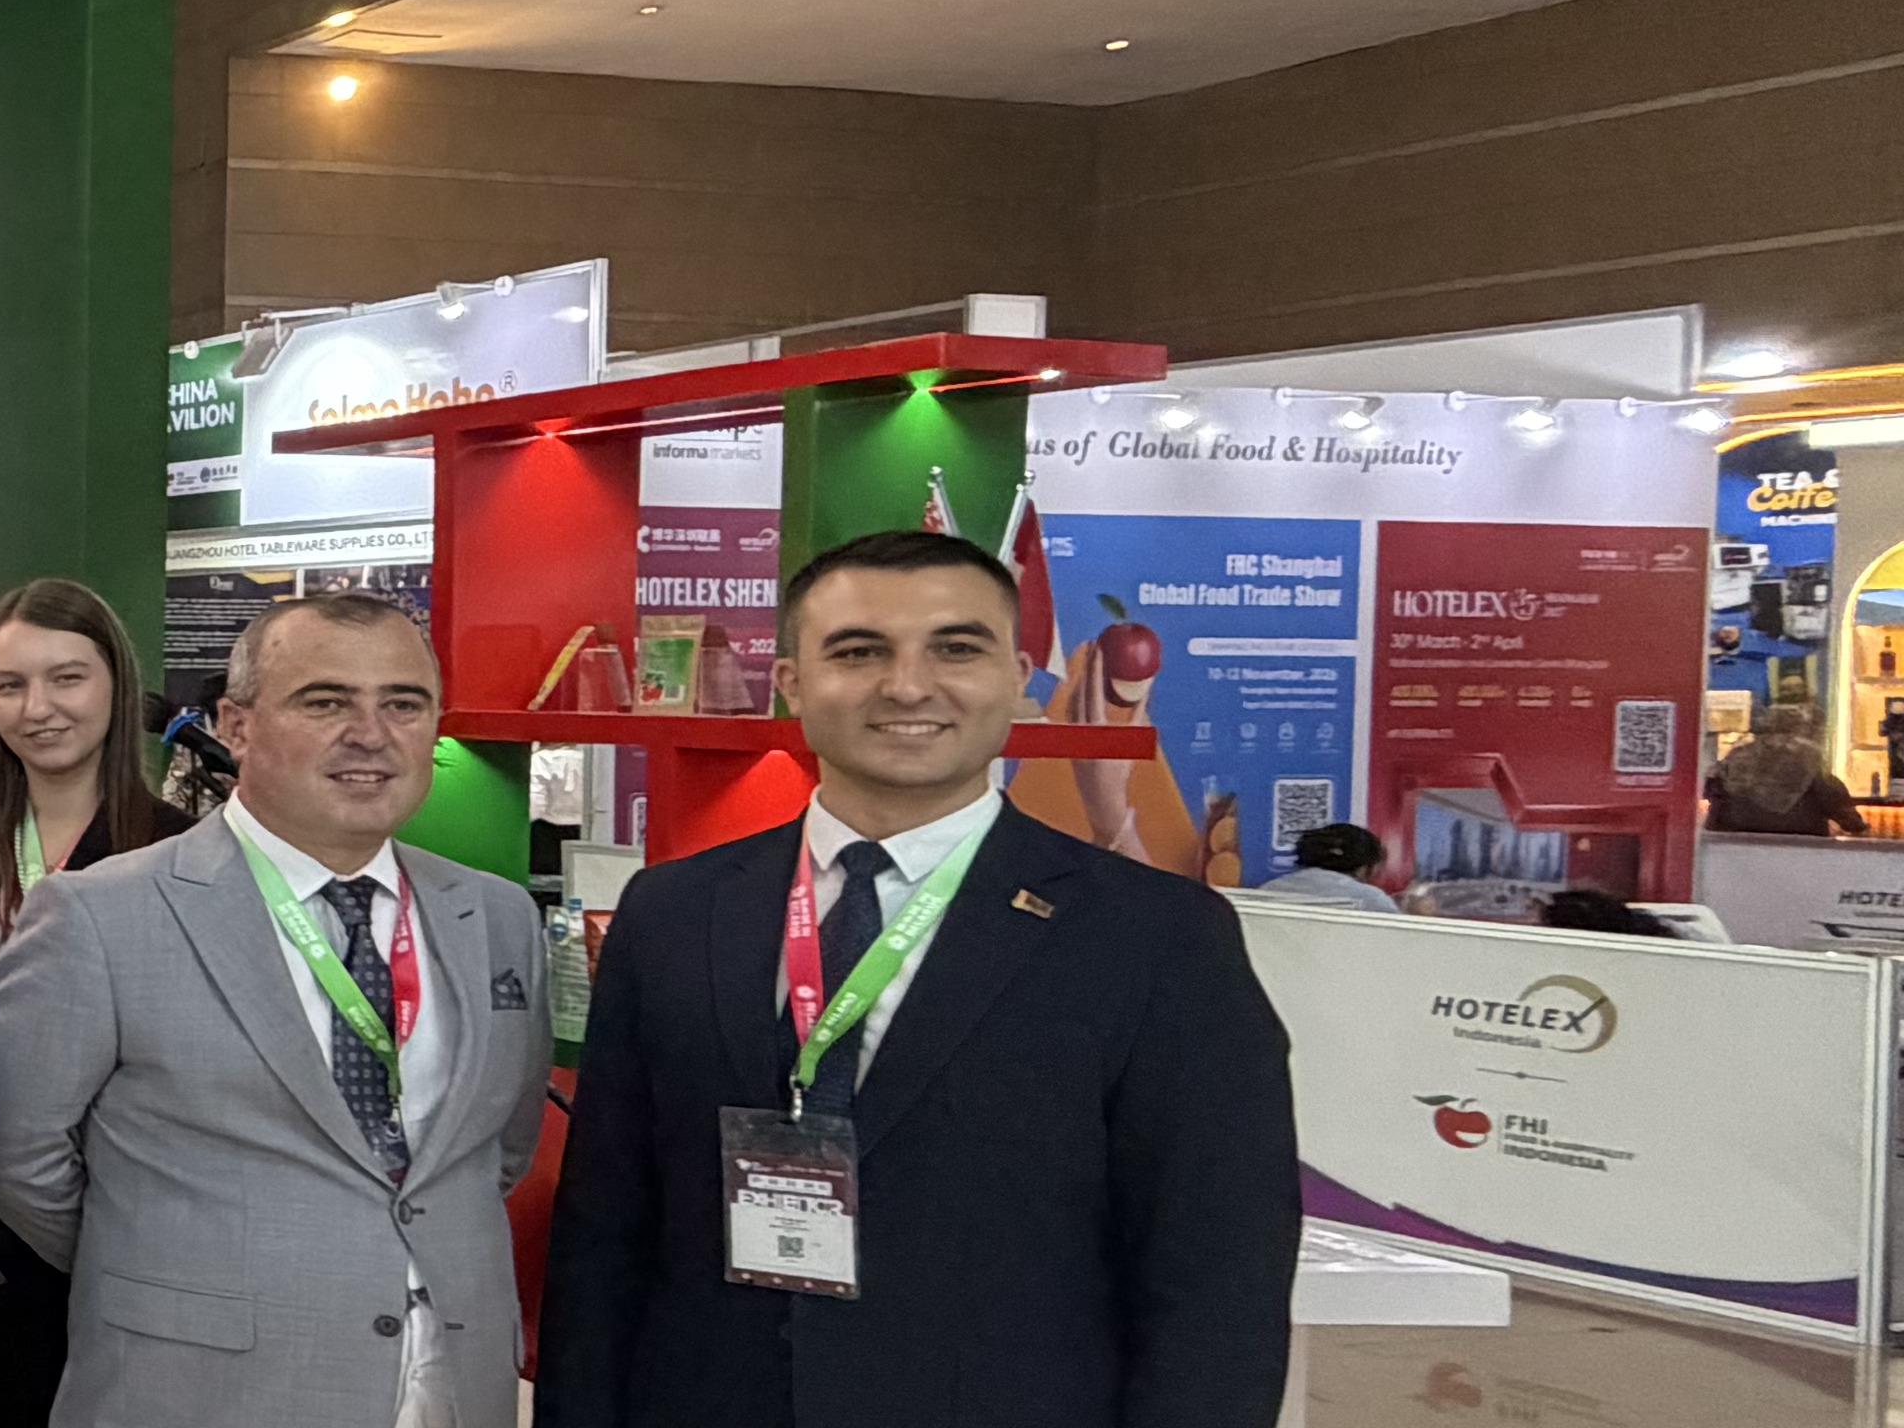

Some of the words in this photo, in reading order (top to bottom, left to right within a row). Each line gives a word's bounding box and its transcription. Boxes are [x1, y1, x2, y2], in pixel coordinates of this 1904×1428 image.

[653, 443, 708, 459] informa
[1064, 431, 1095, 464] of
[1109, 432, 1199, 460] Global
[1210, 434, 1274, 461] Food
[1283, 437, 1304, 462] &
[1313, 437, 1462, 473] Hospitality
[1757, 471, 1812, 490] TEA
[225, 544, 258, 557] HOTEL
[262, 537, 325, 554] TABLEWARE
[329, 535, 384, 550] SUPPLIES
[1226, 554, 1258, 576] FHC
[1261, 555, 1342, 578] Shanghai
[636, 577, 721, 607] HOTELEX
[1139, 583, 1195, 605] Global
[1197, 584, 1239, 605] Food
[1243, 584, 1291, 606] Trade
[1295, 586, 1341, 606] Show
[1393, 590, 1508, 617] HOTELEX
[1432, 995, 1608, 1034] HOTELEX
[1453, 1025, 1542, 1049] Indonesia
[1504, 1115, 1548, 1135] FHI
[1504, 1144, 1607, 1171] INDONESIA
